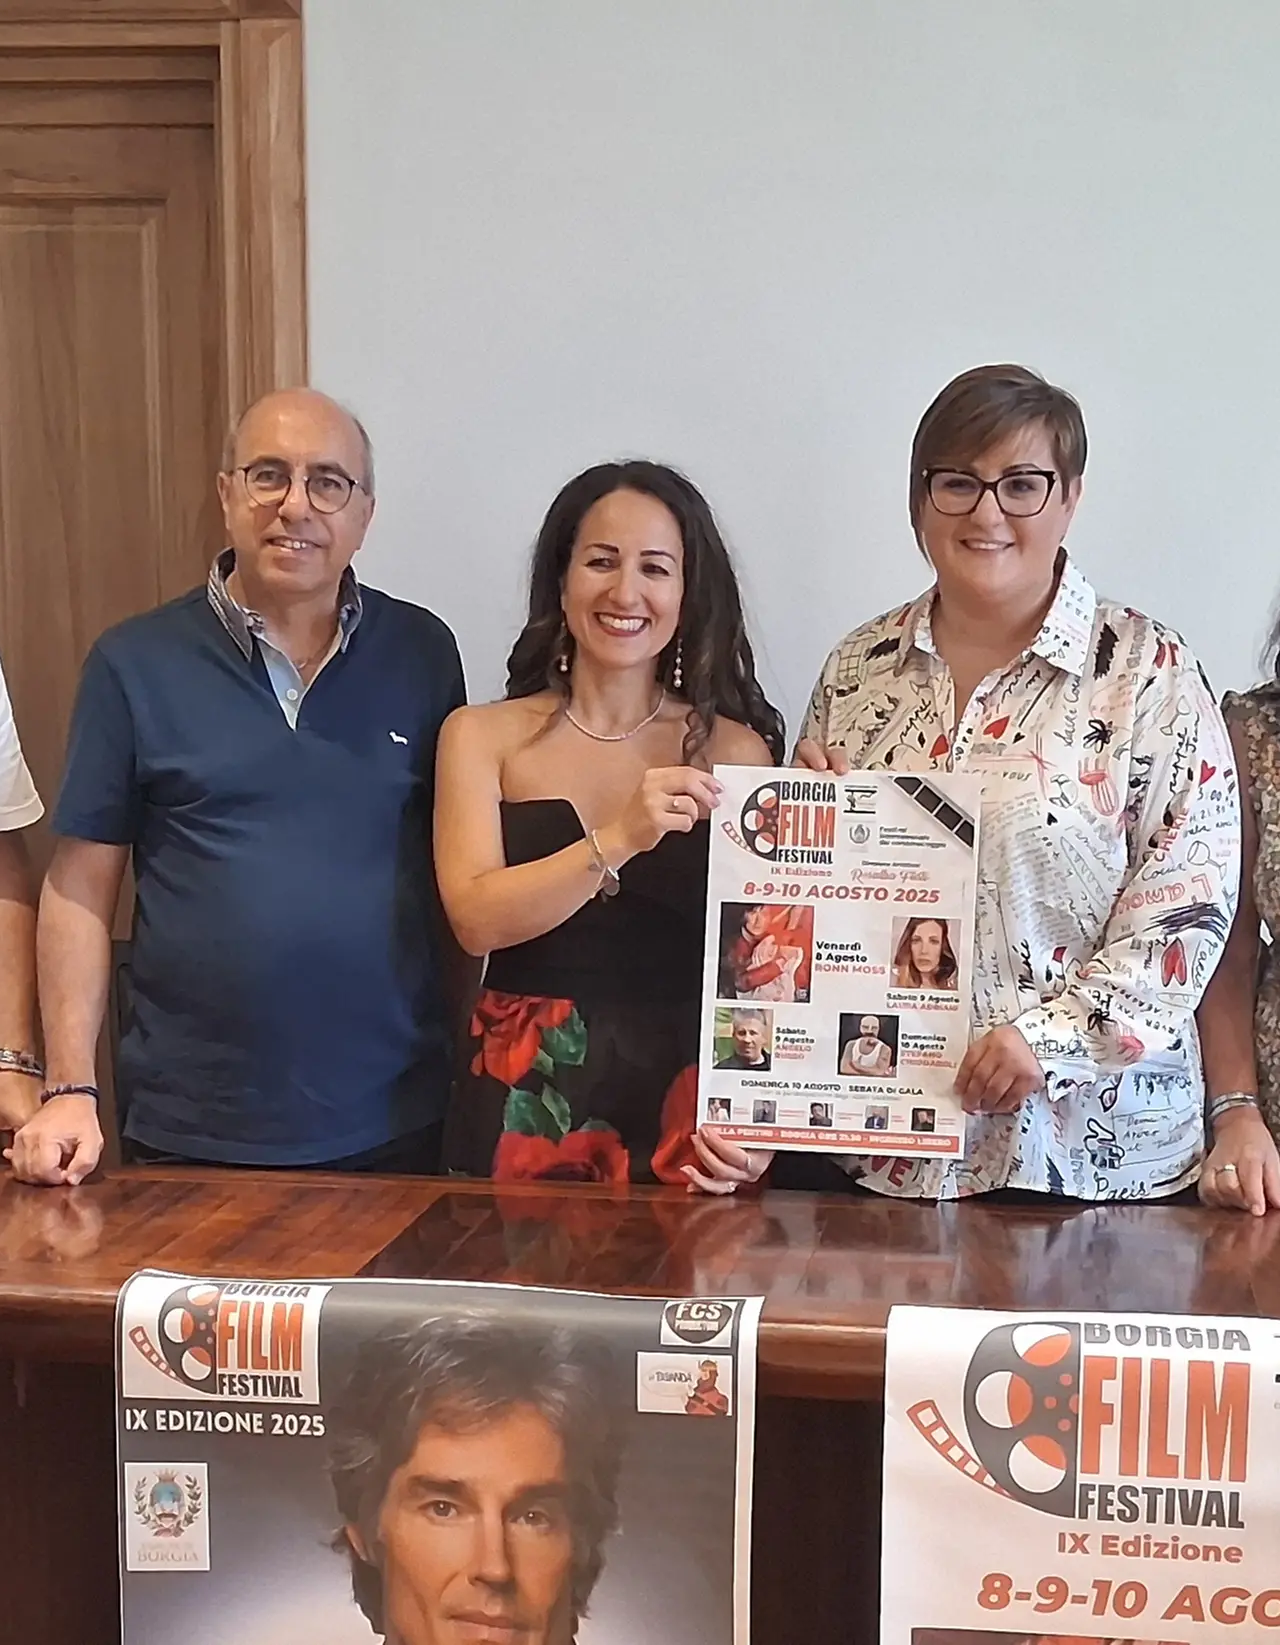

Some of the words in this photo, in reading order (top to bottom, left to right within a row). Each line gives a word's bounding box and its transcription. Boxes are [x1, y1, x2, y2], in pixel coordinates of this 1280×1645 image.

[781, 781, 837, 803] BORGIA
[778, 804, 837, 848] FILM
[777, 849, 834, 865] FESTIVAL
[742, 882, 801, 898] 8-9-10
[806, 886, 889, 901] AGOSTO
[893, 889, 941, 903] 2025
[825, 953, 868, 963] Agosto
[740, 1079, 790, 1089] DOMENICA
[224, 1284, 312, 1299] BORGIA
[675, 1303, 723, 1321] FCS
[220, 1300, 305, 1371] FILM
[1084, 1322, 1251, 1351] BORGIA
[219, 1374, 303, 1398] FESTIVAL
[125, 1408, 148, 1431] IX
[156, 1409, 264, 1434] EDIZIONE
[271, 1414, 326, 1437] 2025
[1080, 1355, 1251, 1482] FILM
[1078, 1483, 1246, 1529] FESTIVAL
[1057, 1532, 1090, 1554] IX
[1101, 1534, 1244, 1563] Edizione
[977, 1573, 1149, 1619] 8-9-10
